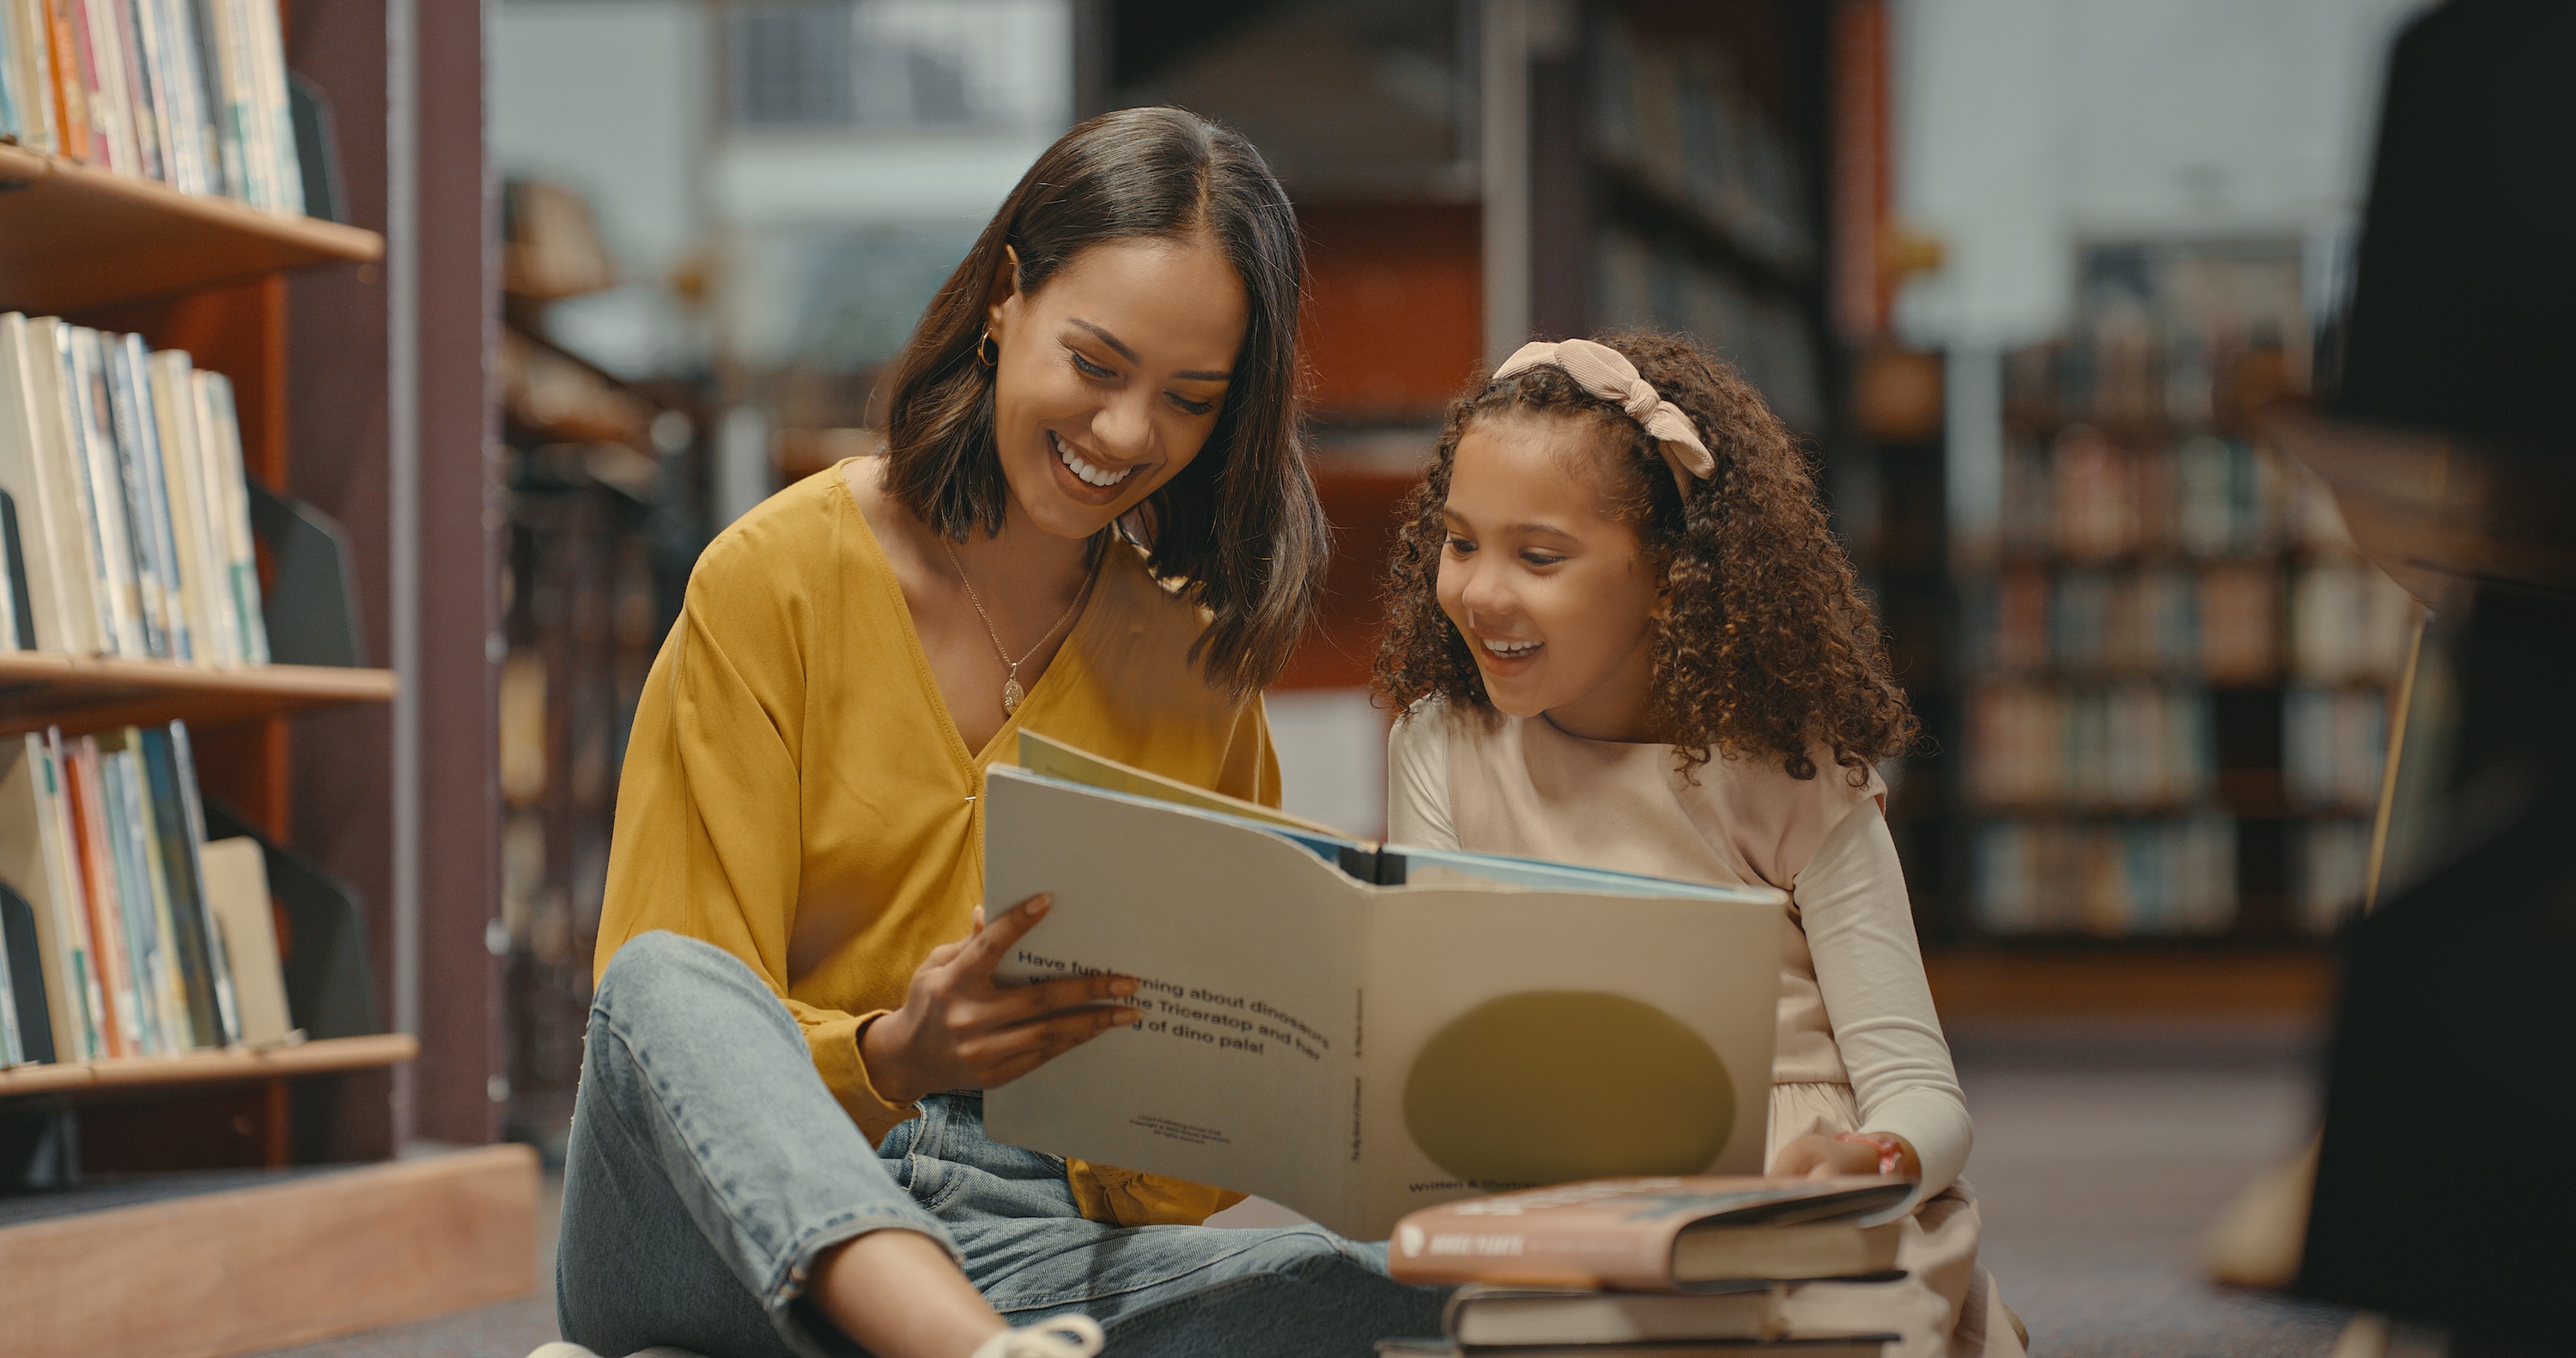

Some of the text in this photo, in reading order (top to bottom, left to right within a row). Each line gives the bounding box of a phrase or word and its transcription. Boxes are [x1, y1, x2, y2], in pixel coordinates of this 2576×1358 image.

[1018, 951, 1065, 971] Have
[1072, 961, 1101, 977] fun
[1189, 987, 1244, 1009] about
[1249, 1000, 1329, 1050] dinosaurs
[1123, 994, 1152, 1010] the
[1157, 999, 1253, 1033] Triceratop
[1259, 1024, 1291, 1046] and
[1296, 1037, 1321, 1062] her
[1148, 1020, 1167, 1034] of
[1171, 1024, 1213, 1044] dino
[1219, 1036, 1264, 1055] pals!
[1408, 1180, 1463, 1193] Written
